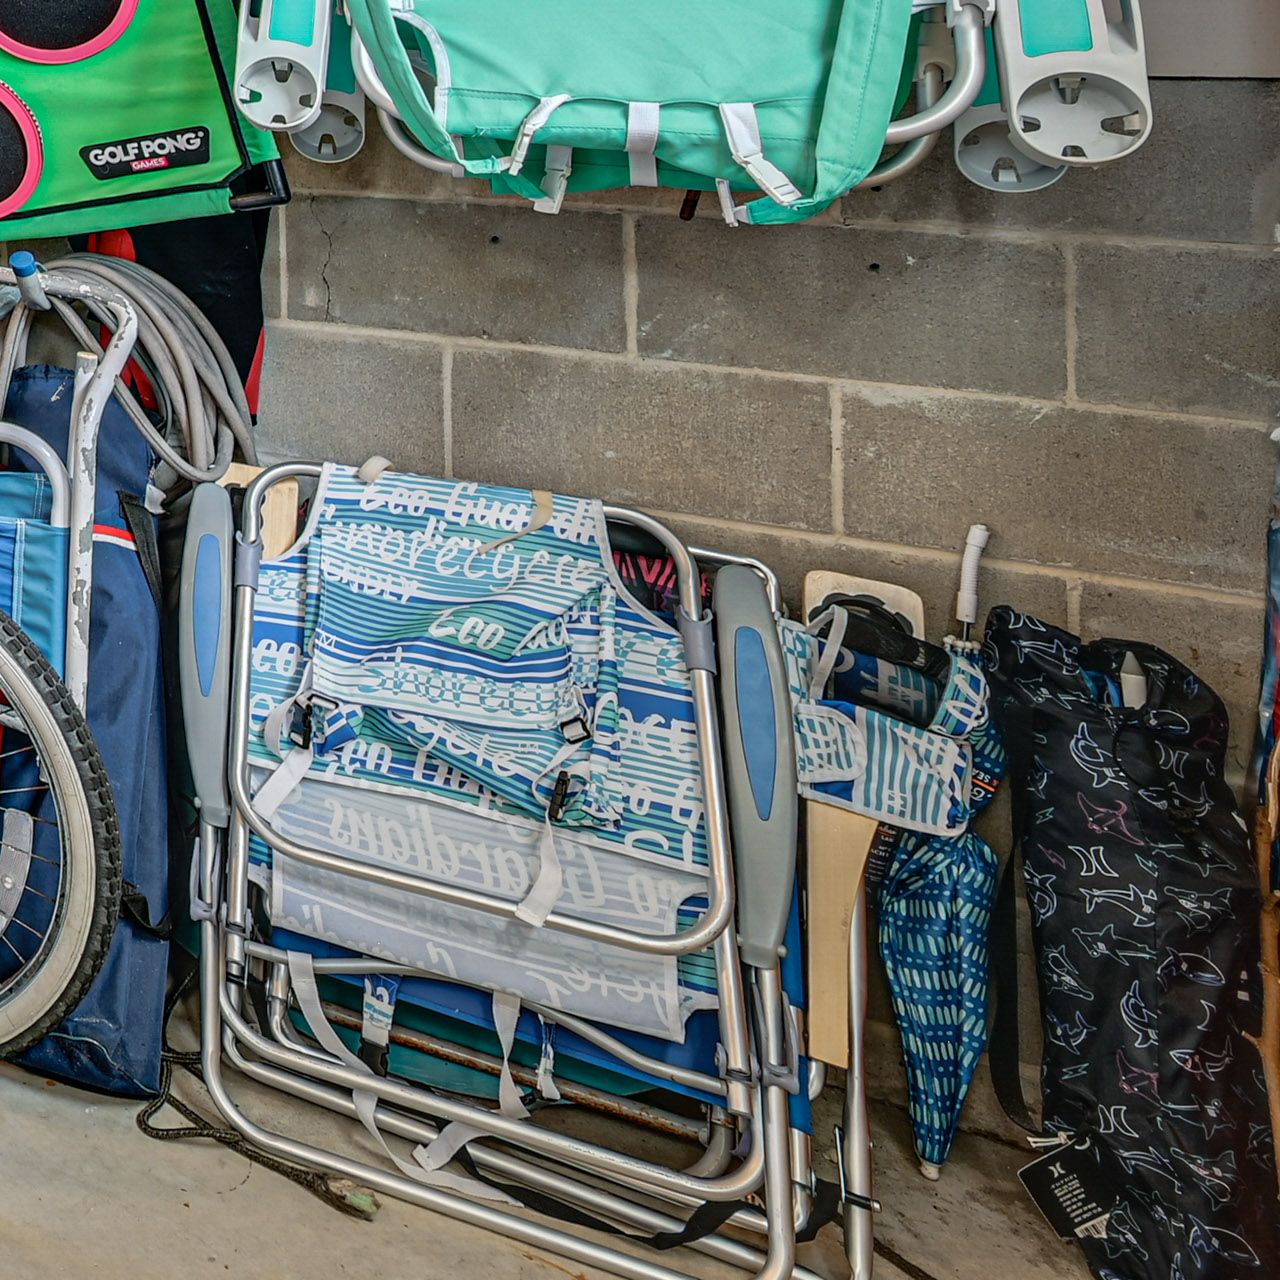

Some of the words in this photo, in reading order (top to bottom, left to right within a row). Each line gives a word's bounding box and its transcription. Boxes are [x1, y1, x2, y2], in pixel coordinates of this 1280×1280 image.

[89, 141, 140, 167] GOLF
[140, 130, 204, 159] PONG
[132, 157, 166, 170] GAMES
